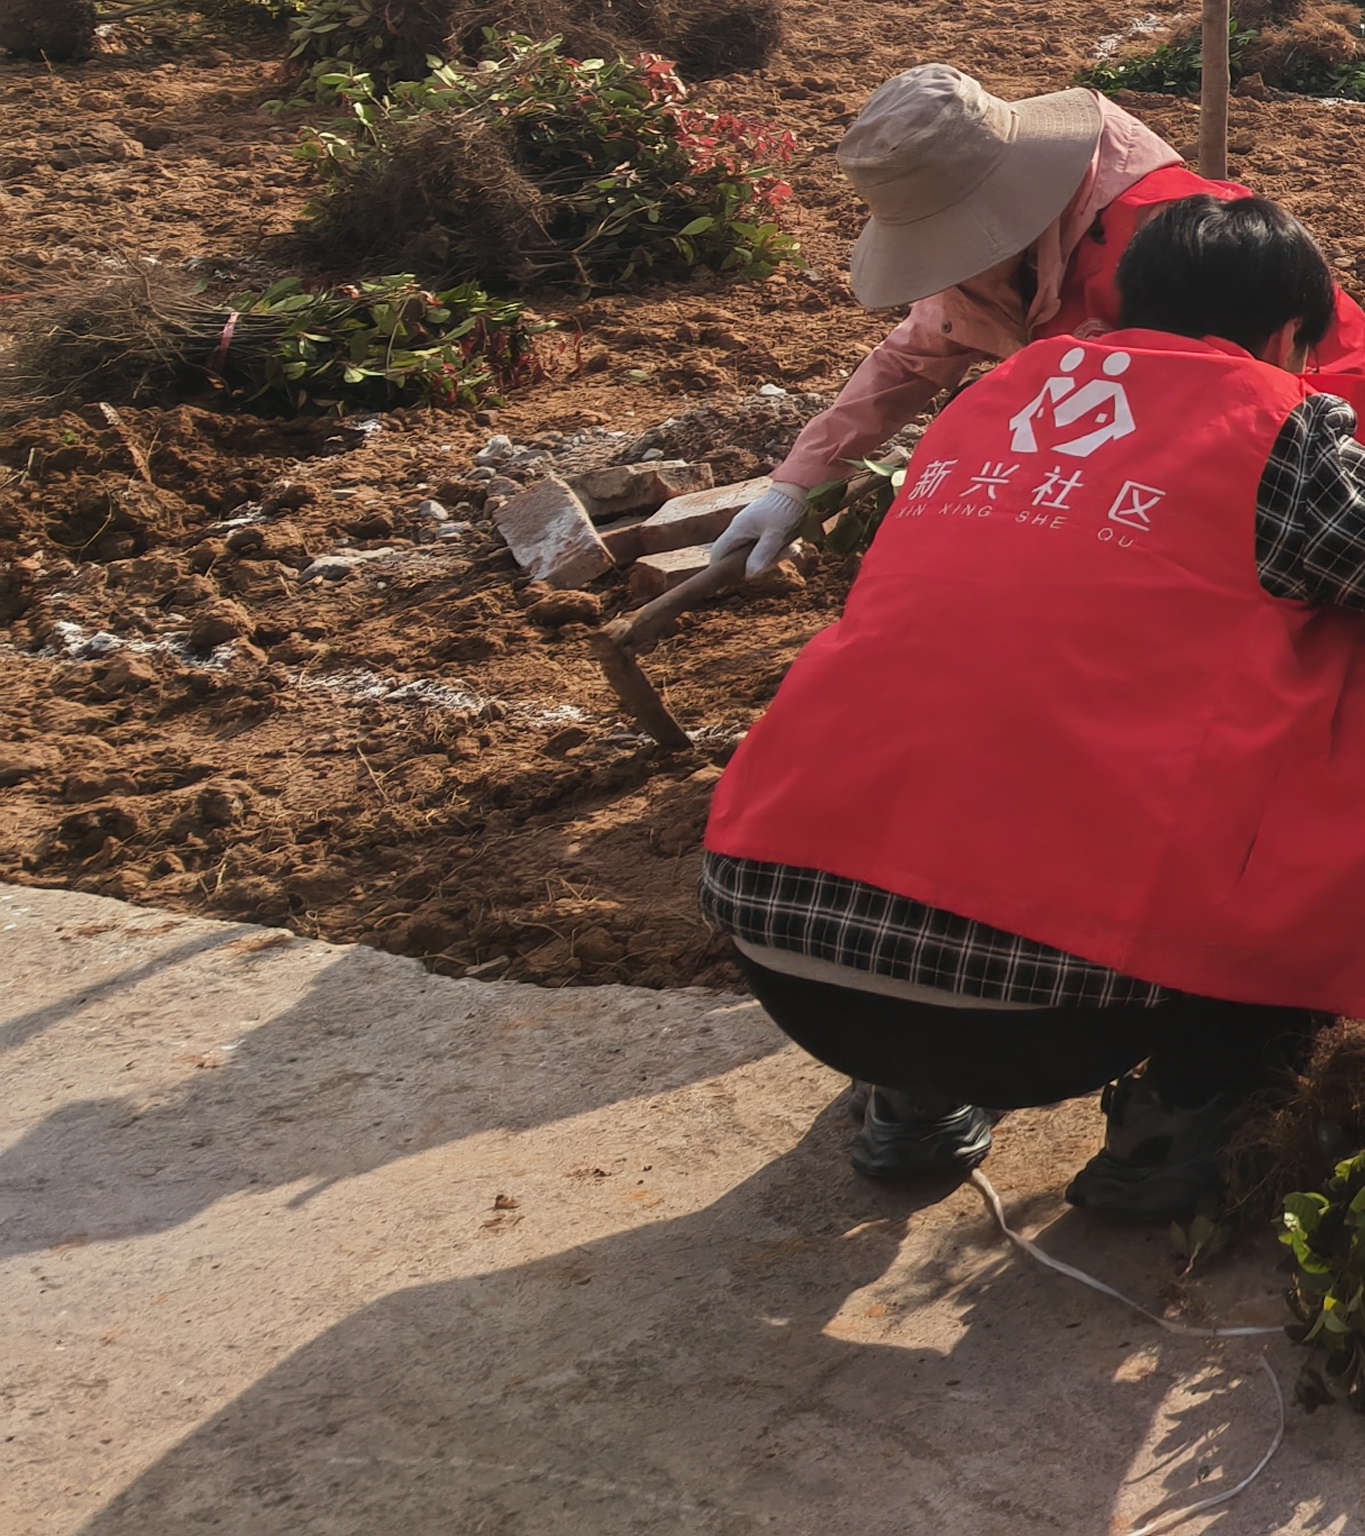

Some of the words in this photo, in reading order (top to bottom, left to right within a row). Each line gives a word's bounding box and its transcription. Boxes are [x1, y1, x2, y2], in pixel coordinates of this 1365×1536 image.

[908, 459, 1166, 531] 新兴社区
[939, 502, 993, 518] XING
[1015, 510, 1068, 530] SHE
[1097, 527, 1134, 549] QU
